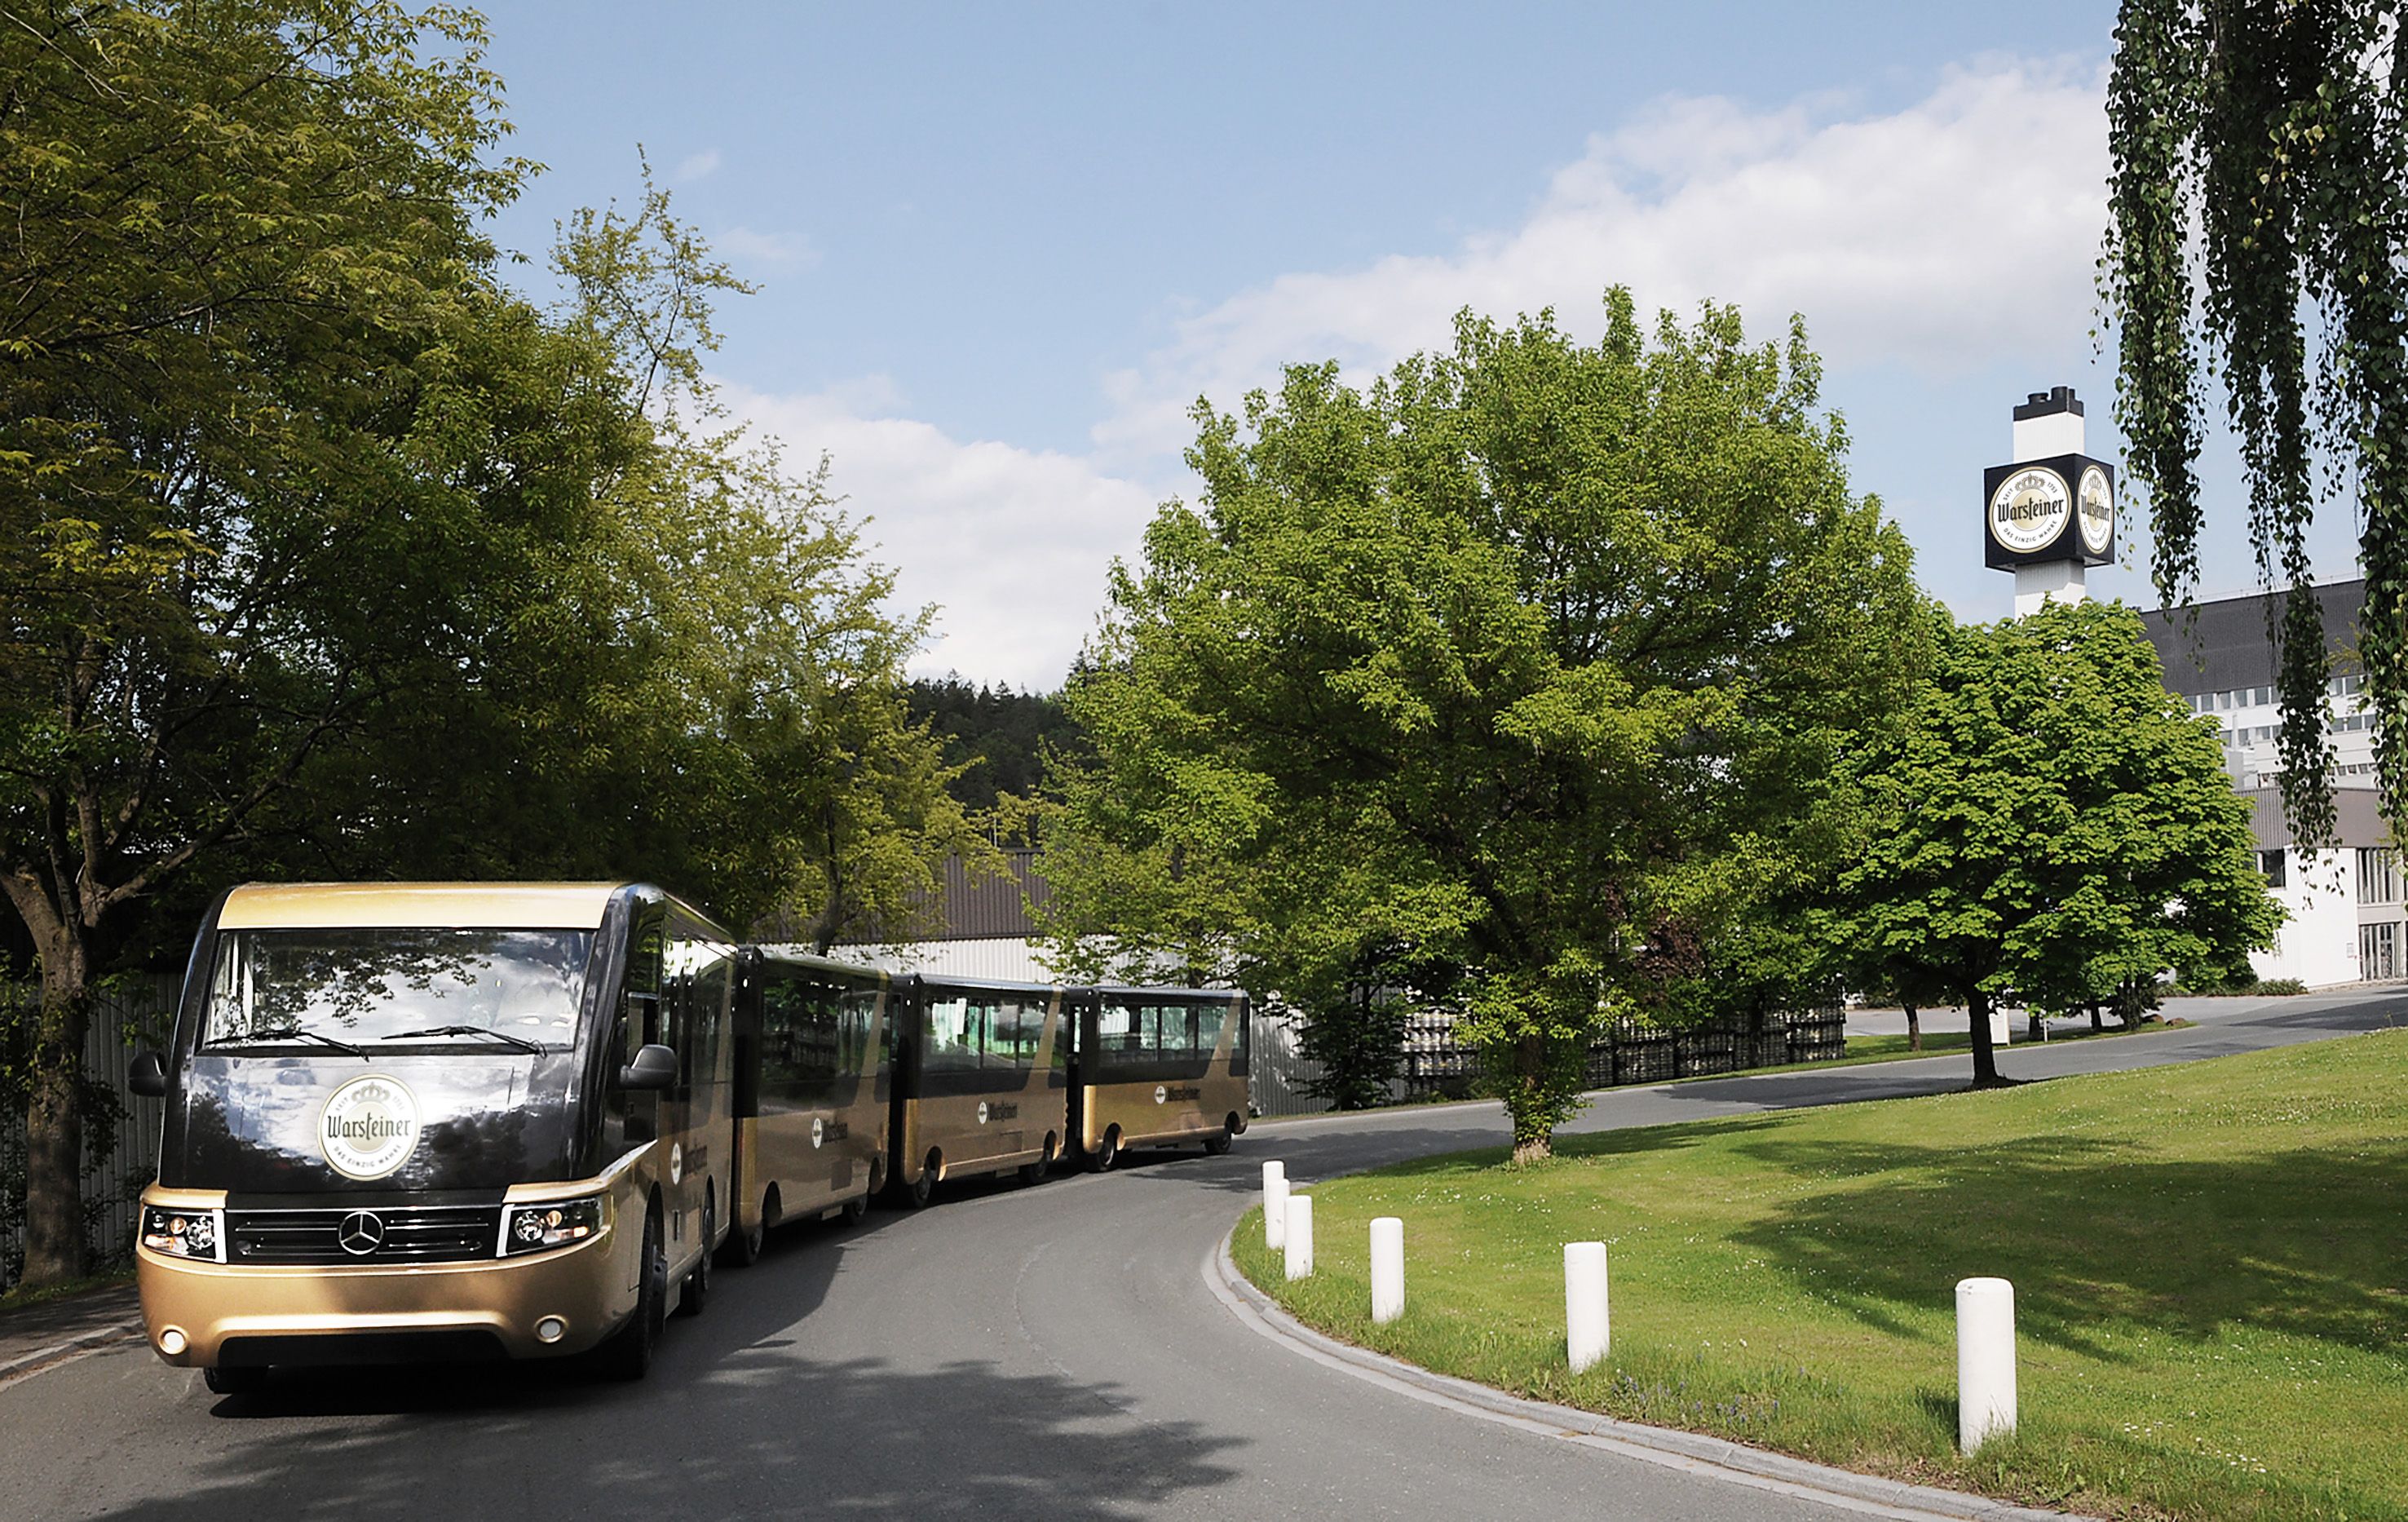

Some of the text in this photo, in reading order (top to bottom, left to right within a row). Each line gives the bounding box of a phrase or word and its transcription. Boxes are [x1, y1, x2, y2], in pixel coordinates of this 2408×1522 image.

[2003, 488, 2013, 500] SEIT
[1997, 497, 2064, 523] Warsteiner
[2081, 494, 2110, 522] Warsteiner
[2004, 528, 2013, 538] DAS
[2039, 520, 2057, 538] WAHRE
[328, 1112, 411, 1140] Warsteiner
